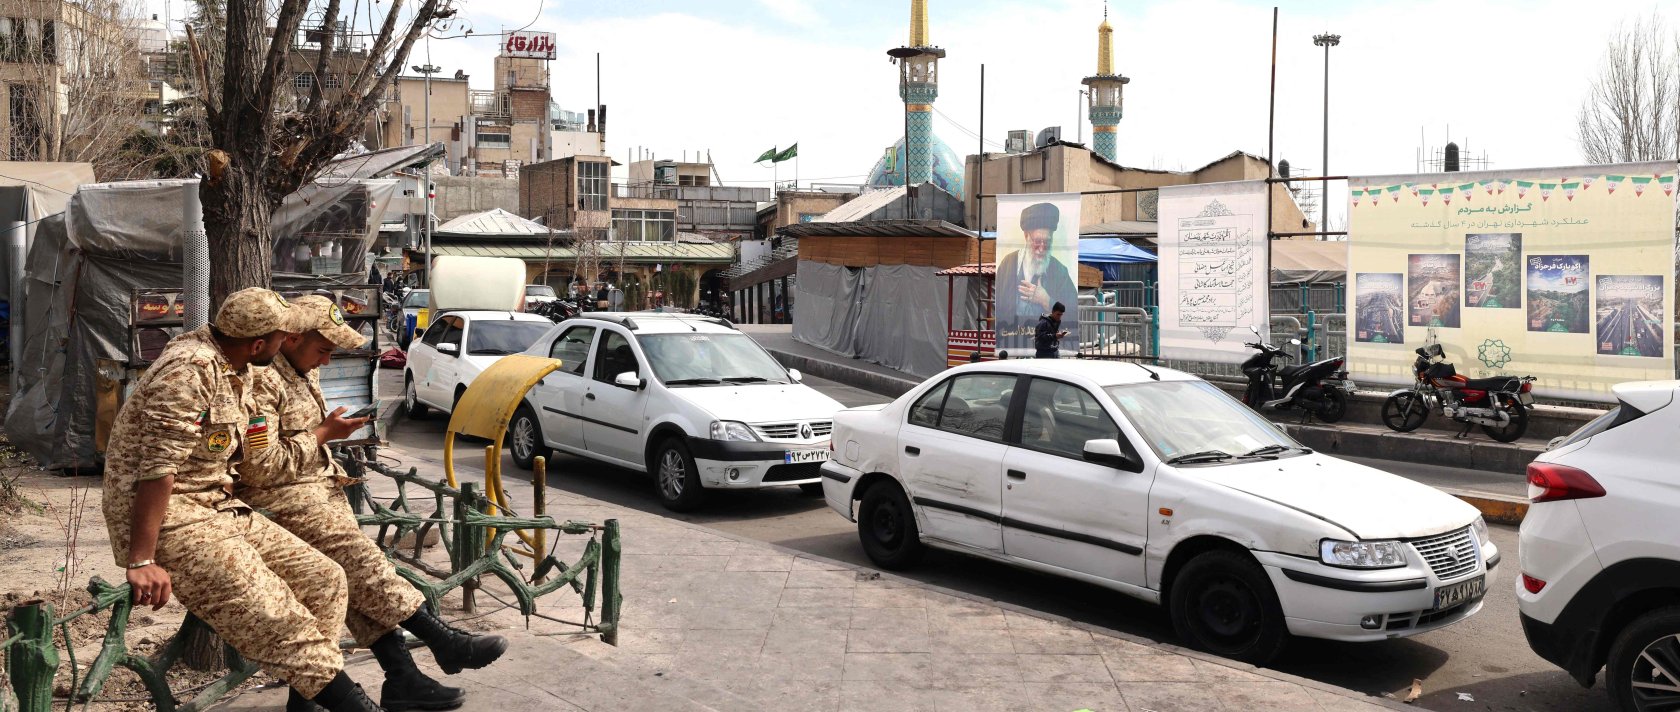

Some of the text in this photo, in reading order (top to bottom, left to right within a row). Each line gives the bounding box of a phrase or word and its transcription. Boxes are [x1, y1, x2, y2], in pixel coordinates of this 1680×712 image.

[526, 35, 555, 56] بازار
[1457, 203, 1533, 216] گزارش به مردم
[1410, 220, 1442, 229] گذشته
[1443, 219, 1459, 230] سال
[1477, 219, 1502, 229] تهران
[1504, 218, 1549, 228] شهرداری
[1550, 217, 1590, 227] عملکرد
